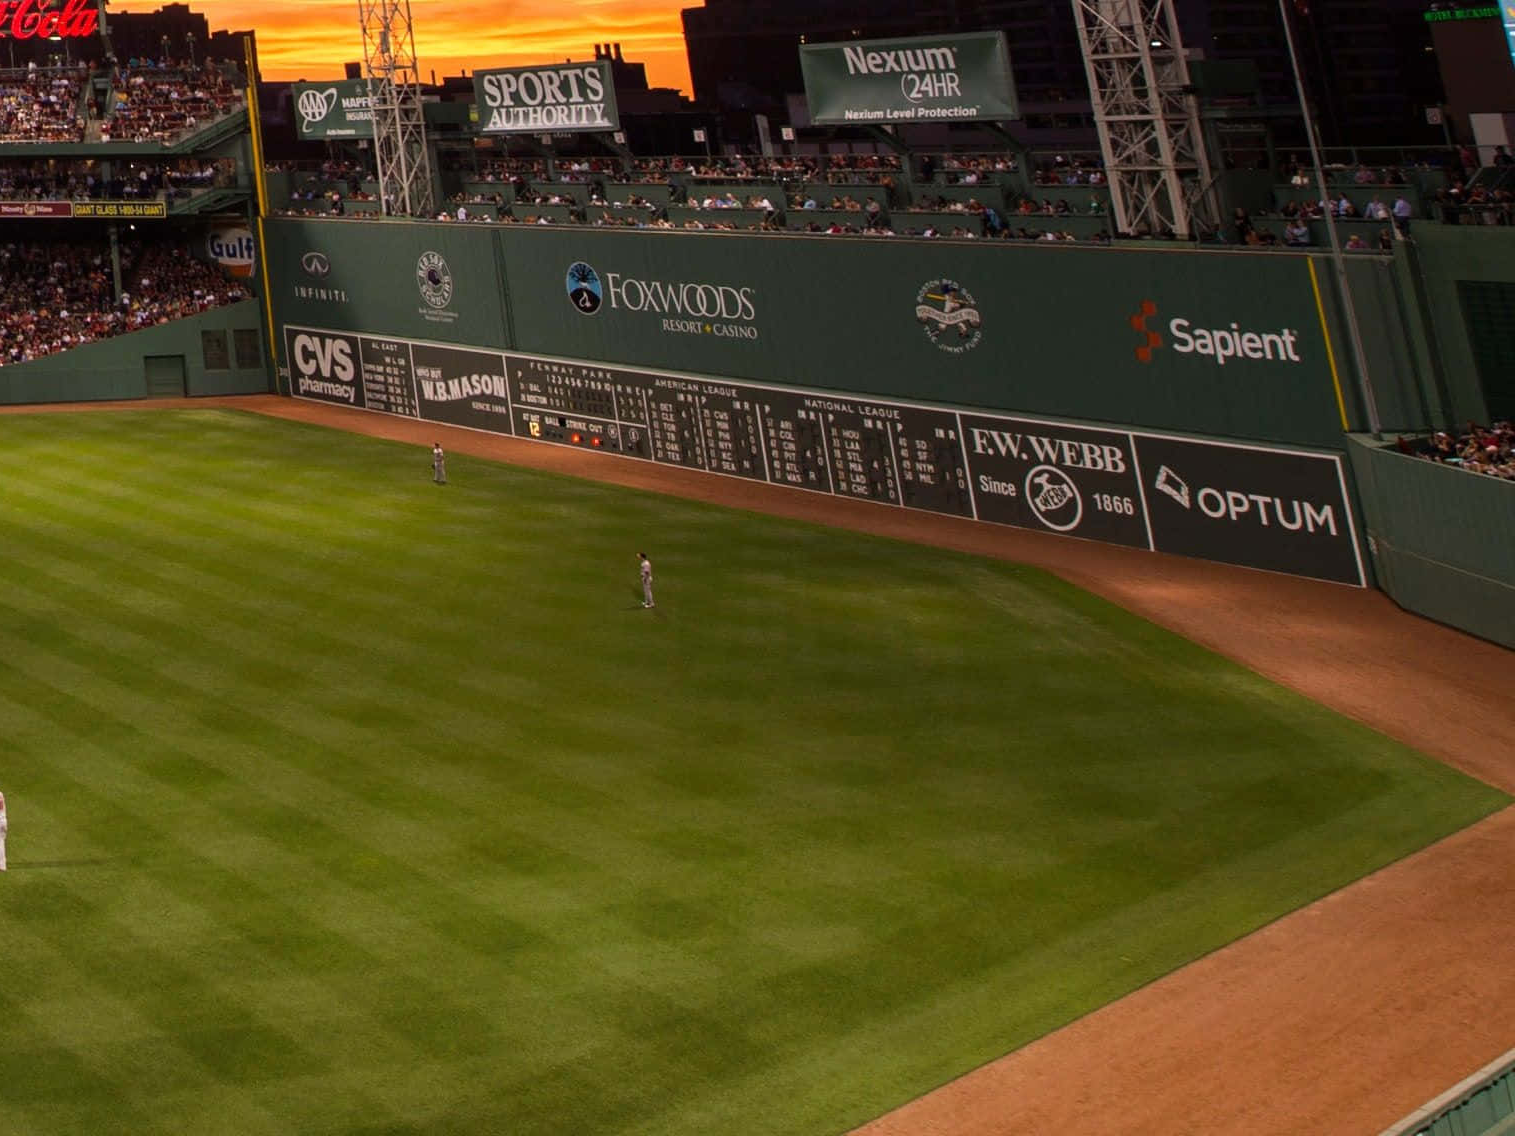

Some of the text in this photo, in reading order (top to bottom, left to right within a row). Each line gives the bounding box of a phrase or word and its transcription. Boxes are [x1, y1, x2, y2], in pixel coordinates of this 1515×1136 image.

[843, 46, 956, 75] Nexium
[483, 66, 603, 107] SPORTS
[845, 106, 976, 119] Nexium Level Protection
[75, 205, 94, 216] GIANT
[96, 205, 118, 216] GLASS
[210, 233, 253, 260] Gulf
[294, 286, 346, 302] INFINITI
[607, 273, 755, 320] FOXWOODS
[662, 319, 757, 339] RESORT CASINO
[1169, 318, 1300, 364] Sapient
[294, 334, 355, 382] CVS
[582, 369, 612, 380] PARK
[298, 375, 355, 403] pharmacy
[654, 379, 738, 398] AMERICAN LEAGUE
[804, 399, 900, 419] NATIONAL LEAGUE
[544, 416, 559, 425] BALL
[589, 423, 603, 433] OUT
[780, 430, 795, 440] COL
[842, 429, 859, 440] HOU
[845, 441, 861, 450] LAA
[969, 427, 1127, 473] F.W. WEBB
[847, 451, 862, 462] STL
[917, 451, 928, 461] SF
[916, 463, 934, 473] NYM
[786, 472, 802, 483] WAS
[850, 473, 866, 483] LAD
[851, 484, 869, 495] CHC
[979, 474, 1134, 516] Since 1866
[1197, 487, 1338, 536] OPTUM
